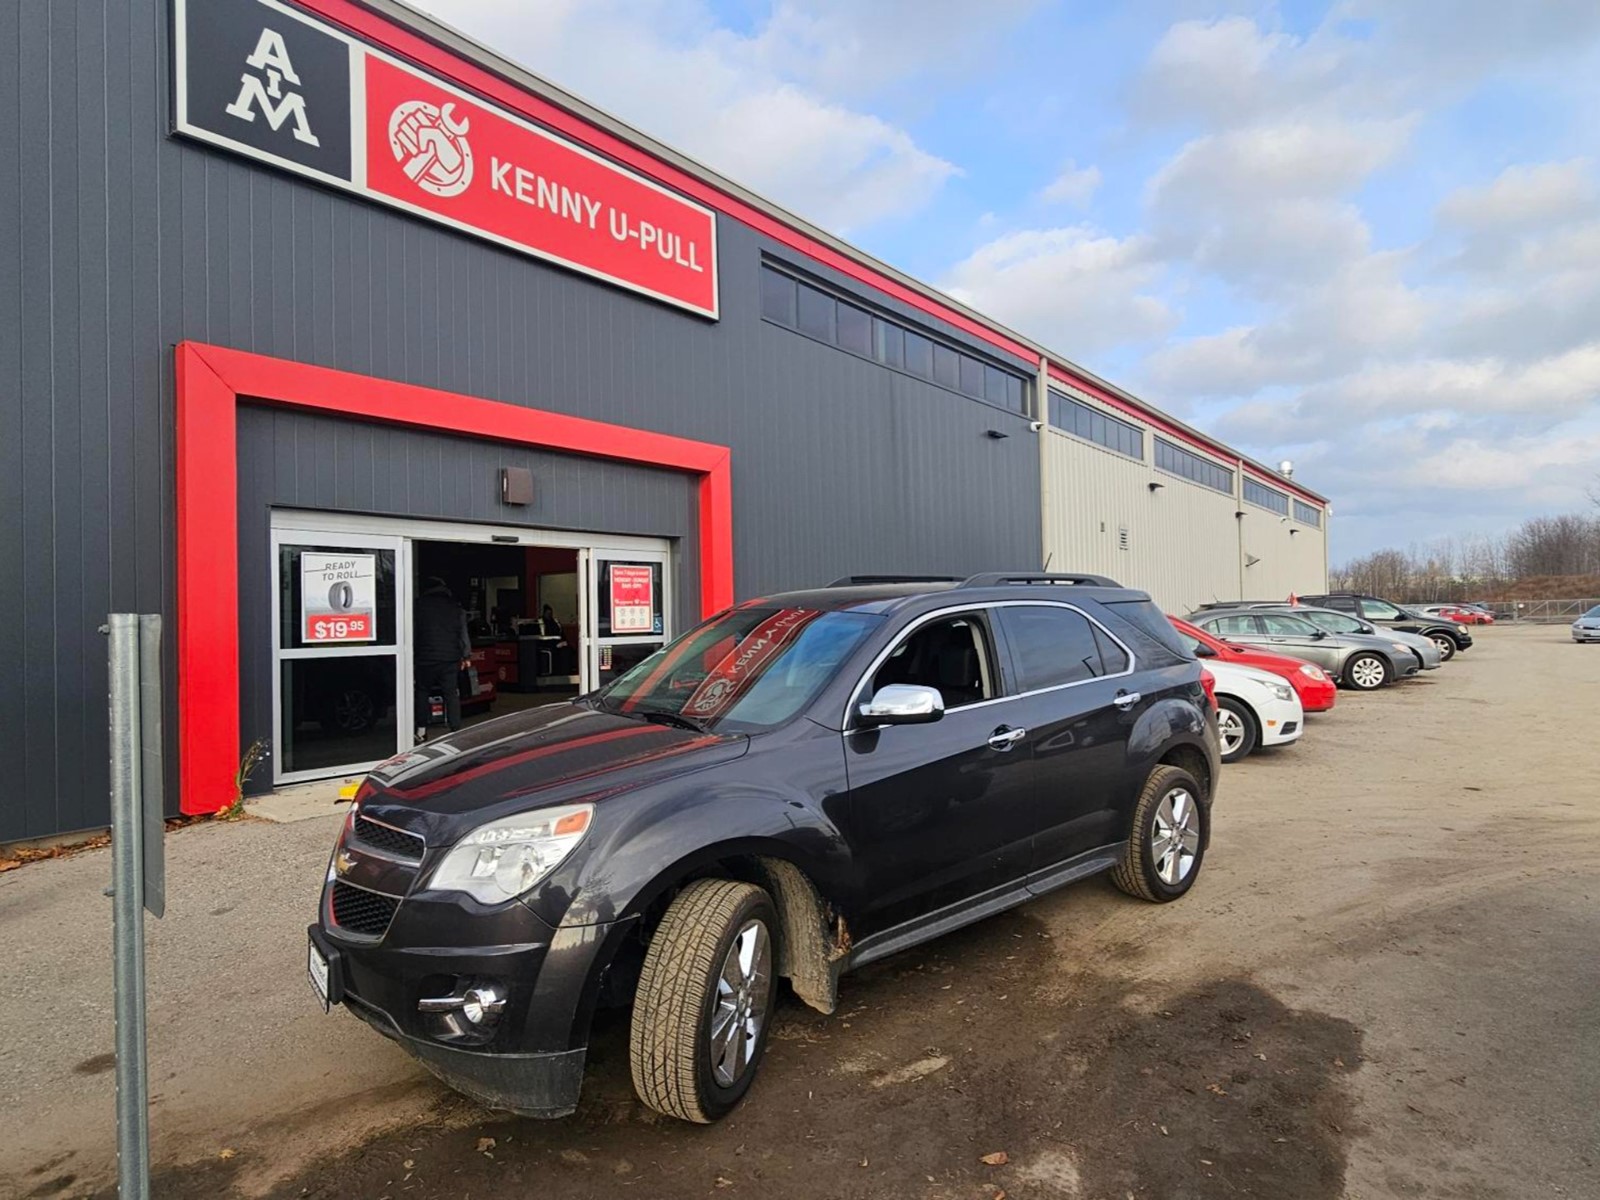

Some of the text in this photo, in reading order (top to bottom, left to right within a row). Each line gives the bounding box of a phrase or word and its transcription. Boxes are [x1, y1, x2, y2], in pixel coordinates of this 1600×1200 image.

[225, 27, 320, 148] AIM
[491, 156, 704, 272] KENNY U-PULL
[322, 571, 359, 581] TO ROLL
[325, 561, 356, 571] READY
